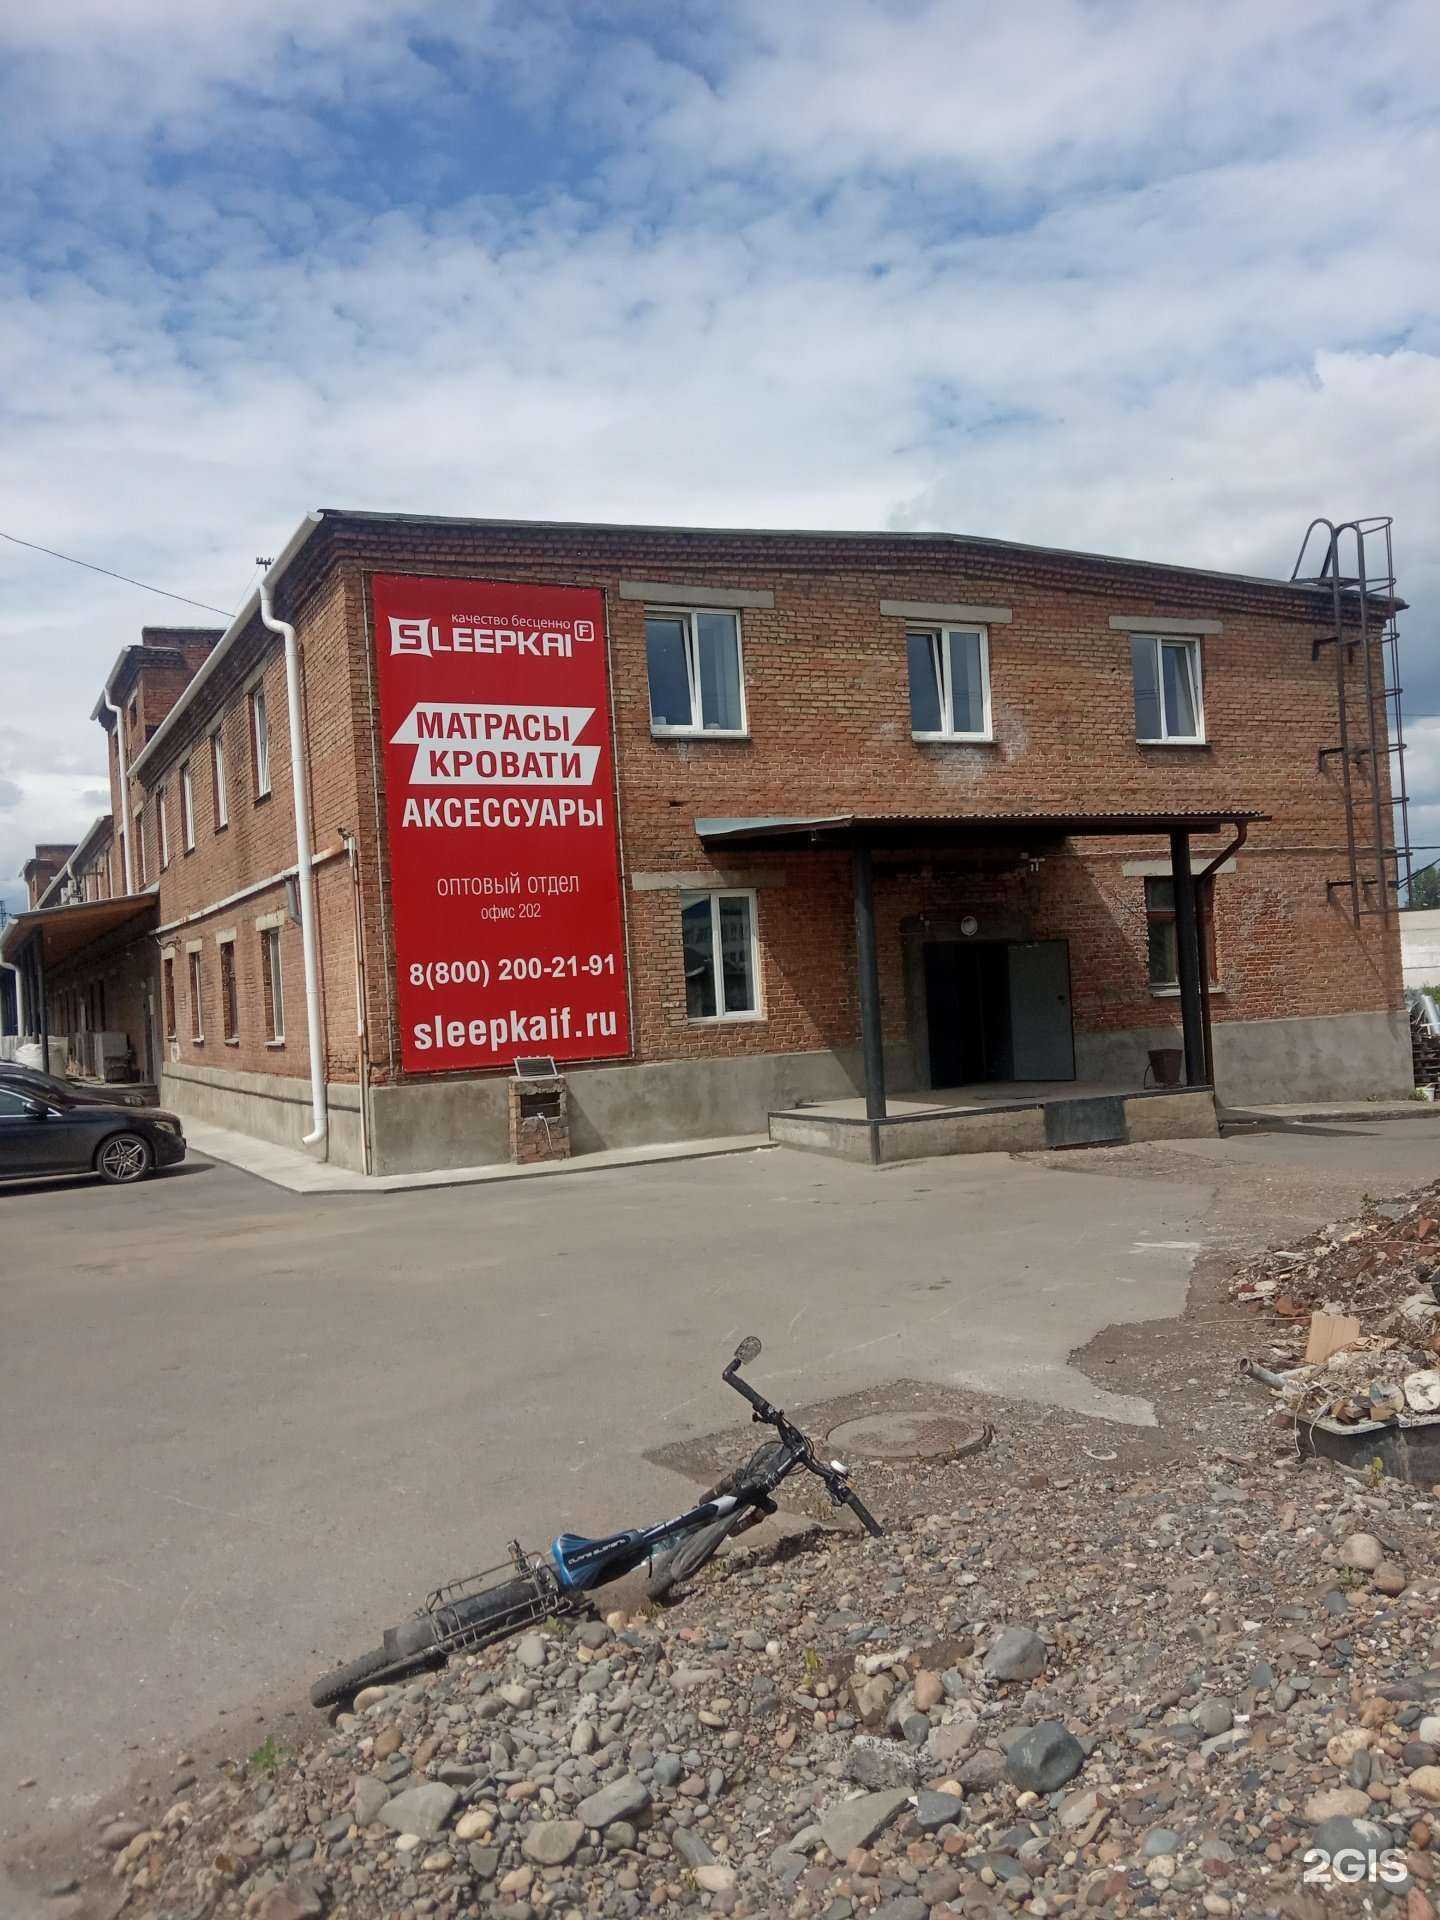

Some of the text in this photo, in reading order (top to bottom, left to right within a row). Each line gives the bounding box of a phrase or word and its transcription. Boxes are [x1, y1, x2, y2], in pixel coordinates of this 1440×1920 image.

[451, 613, 571, 630] качество бесценно
[416, 711, 570, 742] МАТРАСЫ
[429, 750, 582, 778] КРОВАТИ
[401, 797, 604, 828] АКСЕССУАРЫ
[437, 872, 580, 896] оптовый отдел
[481, 903, 542, 922] офис 202
[409, 953, 616, 990] 8(800) 200-21-91
[413, 1006, 617, 1052] sleepkaif.ru
